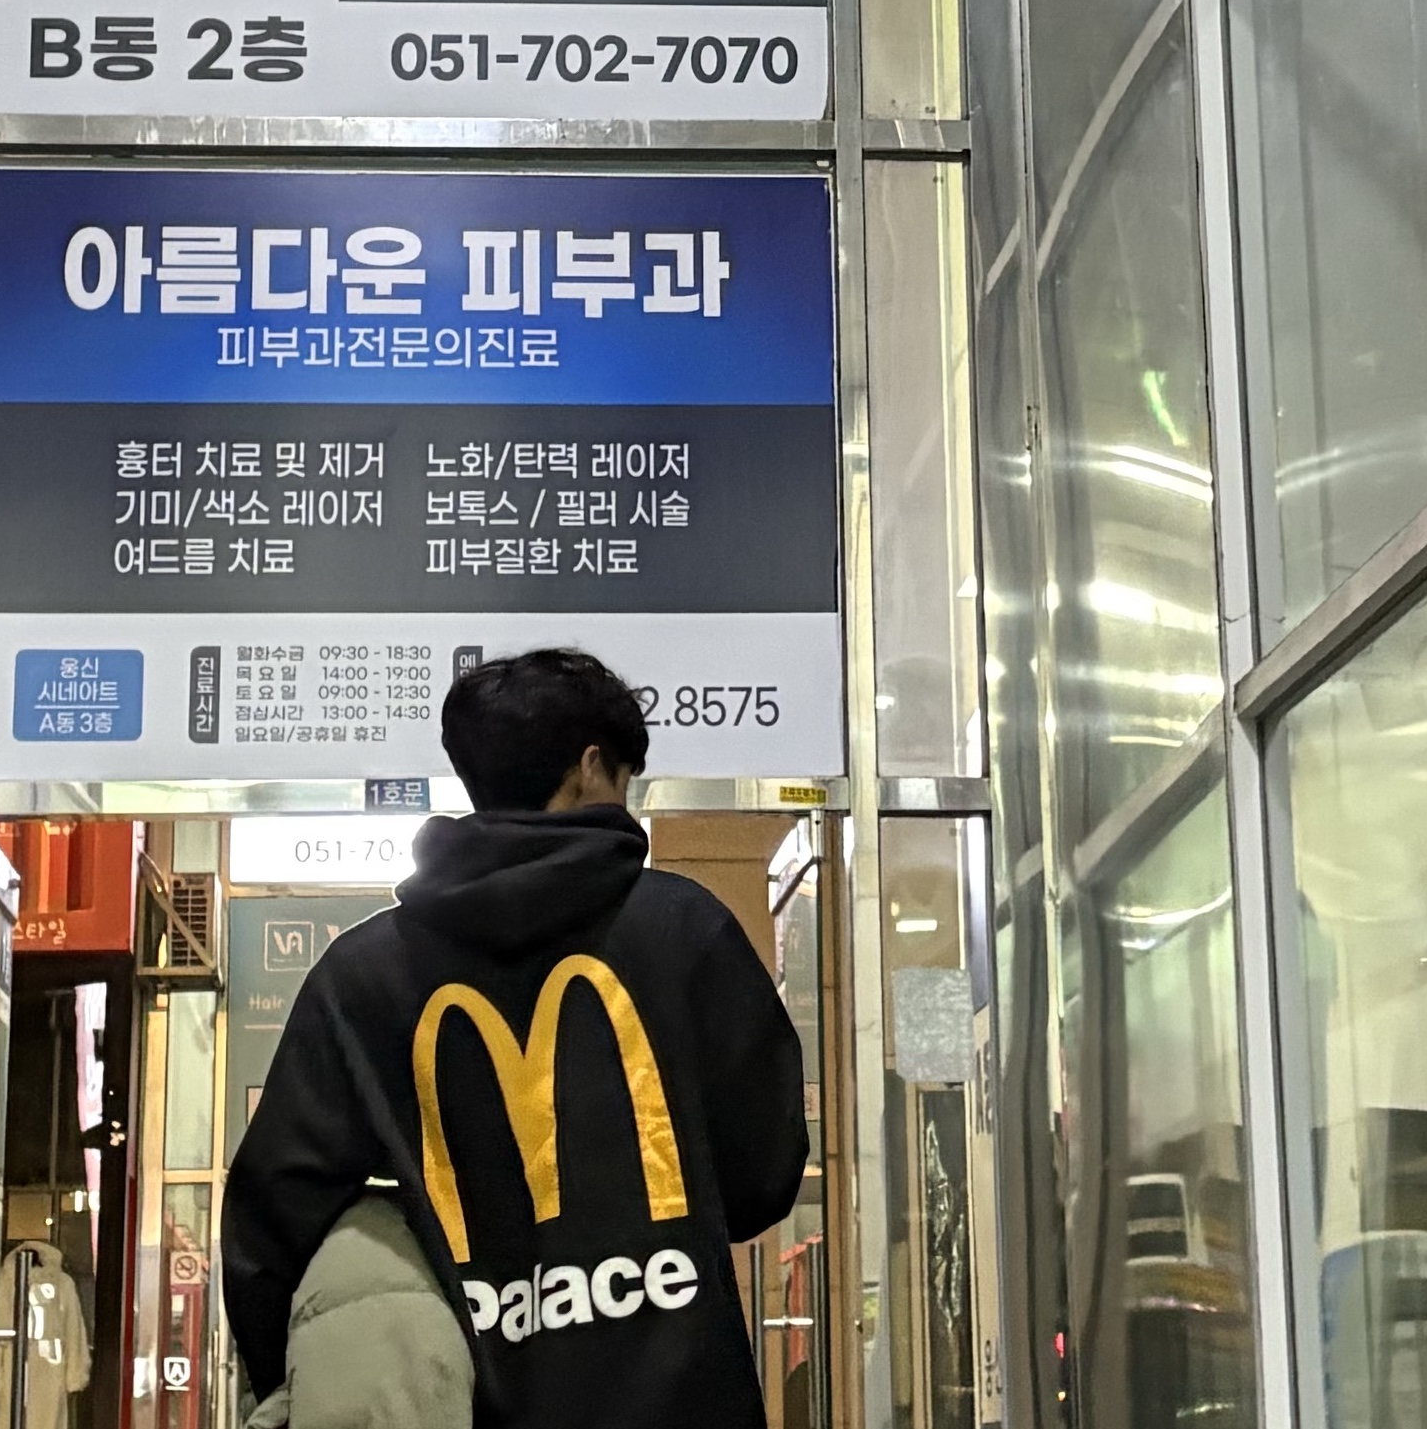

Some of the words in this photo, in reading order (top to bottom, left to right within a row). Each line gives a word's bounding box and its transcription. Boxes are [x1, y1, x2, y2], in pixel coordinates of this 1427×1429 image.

[29, 16, 157, 81] B동
[187, 15, 308, 82] 2층
[390, 33, 799, 85] 051-702-7070
[63, 225, 427, 316] 아름다운
[462, 228, 730, 319] 피부과
[216, 326, 561, 371] 피부과전문의진료
[115, 441, 183, 479] 흉터
[196, 441, 262, 479] 치료
[275, 441, 306, 479] 및
[319, 441, 385, 479] 제거
[426, 442, 578, 479] 노화/탄력
[591, 442, 690, 479] 레이저
[115, 490, 270, 528] 기미/색소
[283, 490, 385, 528] 레이저
[426, 490, 519, 528] 보톡스
[556, 490, 617, 528] 필러
[630, 490, 690, 528] 시술
[114, 537, 215, 576] 여드름
[228, 537, 294, 576] 치료
[426, 537, 561, 576] 피부질환
[573, 537, 639, 576] 치료
[319, 646, 369, 660] 09:30
[386, 646, 431, 660] 18:30
[38, 680, 118, 702] 시네아트
[322, 666, 368, 680] 14:00
[385, 666, 431, 680] 19:00
[195, 657, 215, 733] 진료시간
[318, 685, 368, 700] 09:00
[386, 685, 431, 700] 12:30
[39, 712, 75, 734] A동
[80, 712, 112, 733] 3층
[322, 705, 367, 720] 13:00
[385, 705, 430, 720] 14:30
[371, 780, 424, 807] 1호문
[294, 838, 404, 863] 051-70
